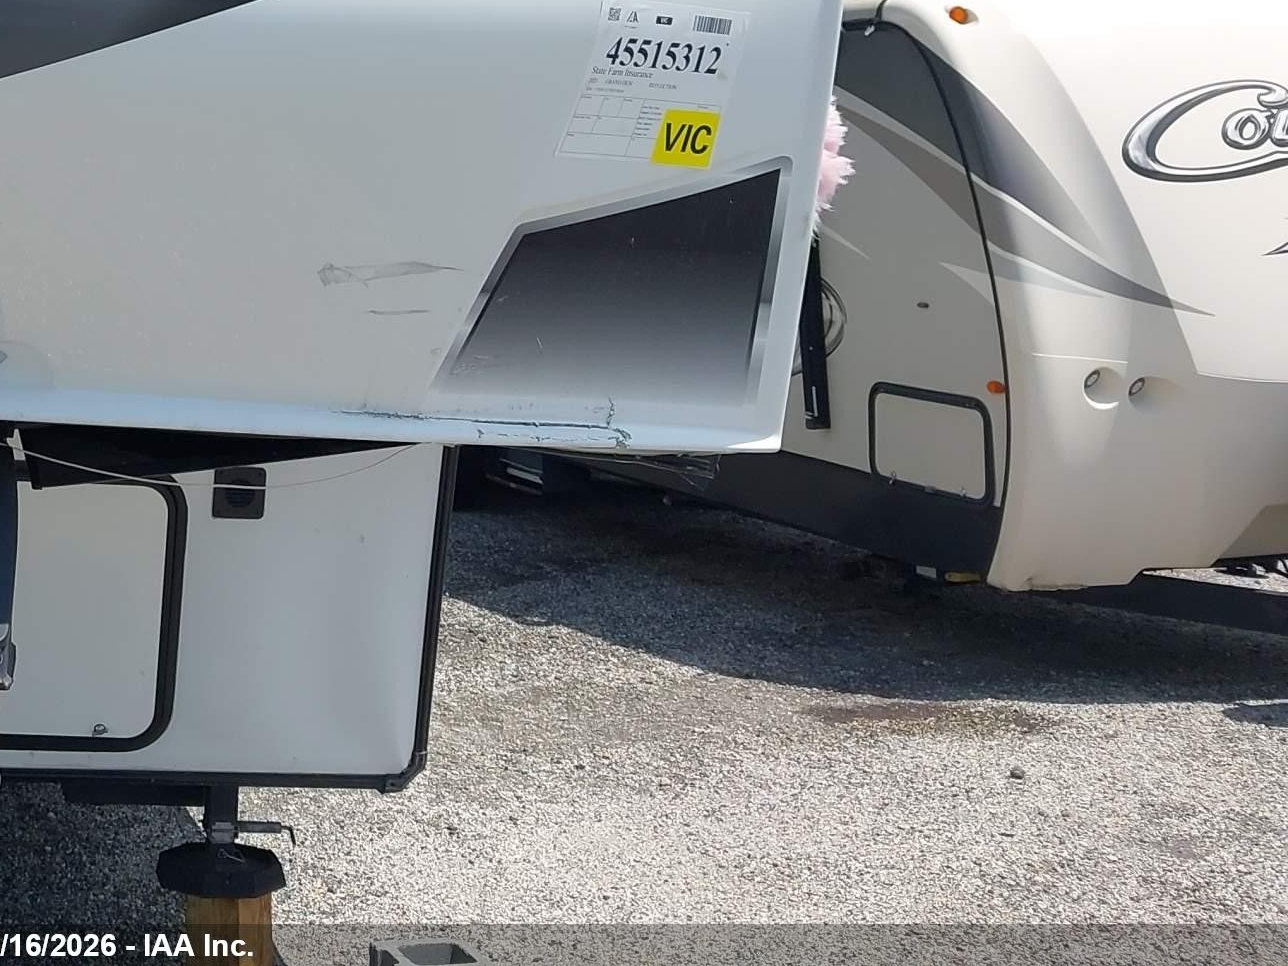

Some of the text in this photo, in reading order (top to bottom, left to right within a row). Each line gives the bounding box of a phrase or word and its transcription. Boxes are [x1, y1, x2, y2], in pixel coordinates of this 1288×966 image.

[606, 36, 722, 75] 45515312
[591, 65, 654, 80] State Farm Insurance
[664, 122, 712, 155] VIC
